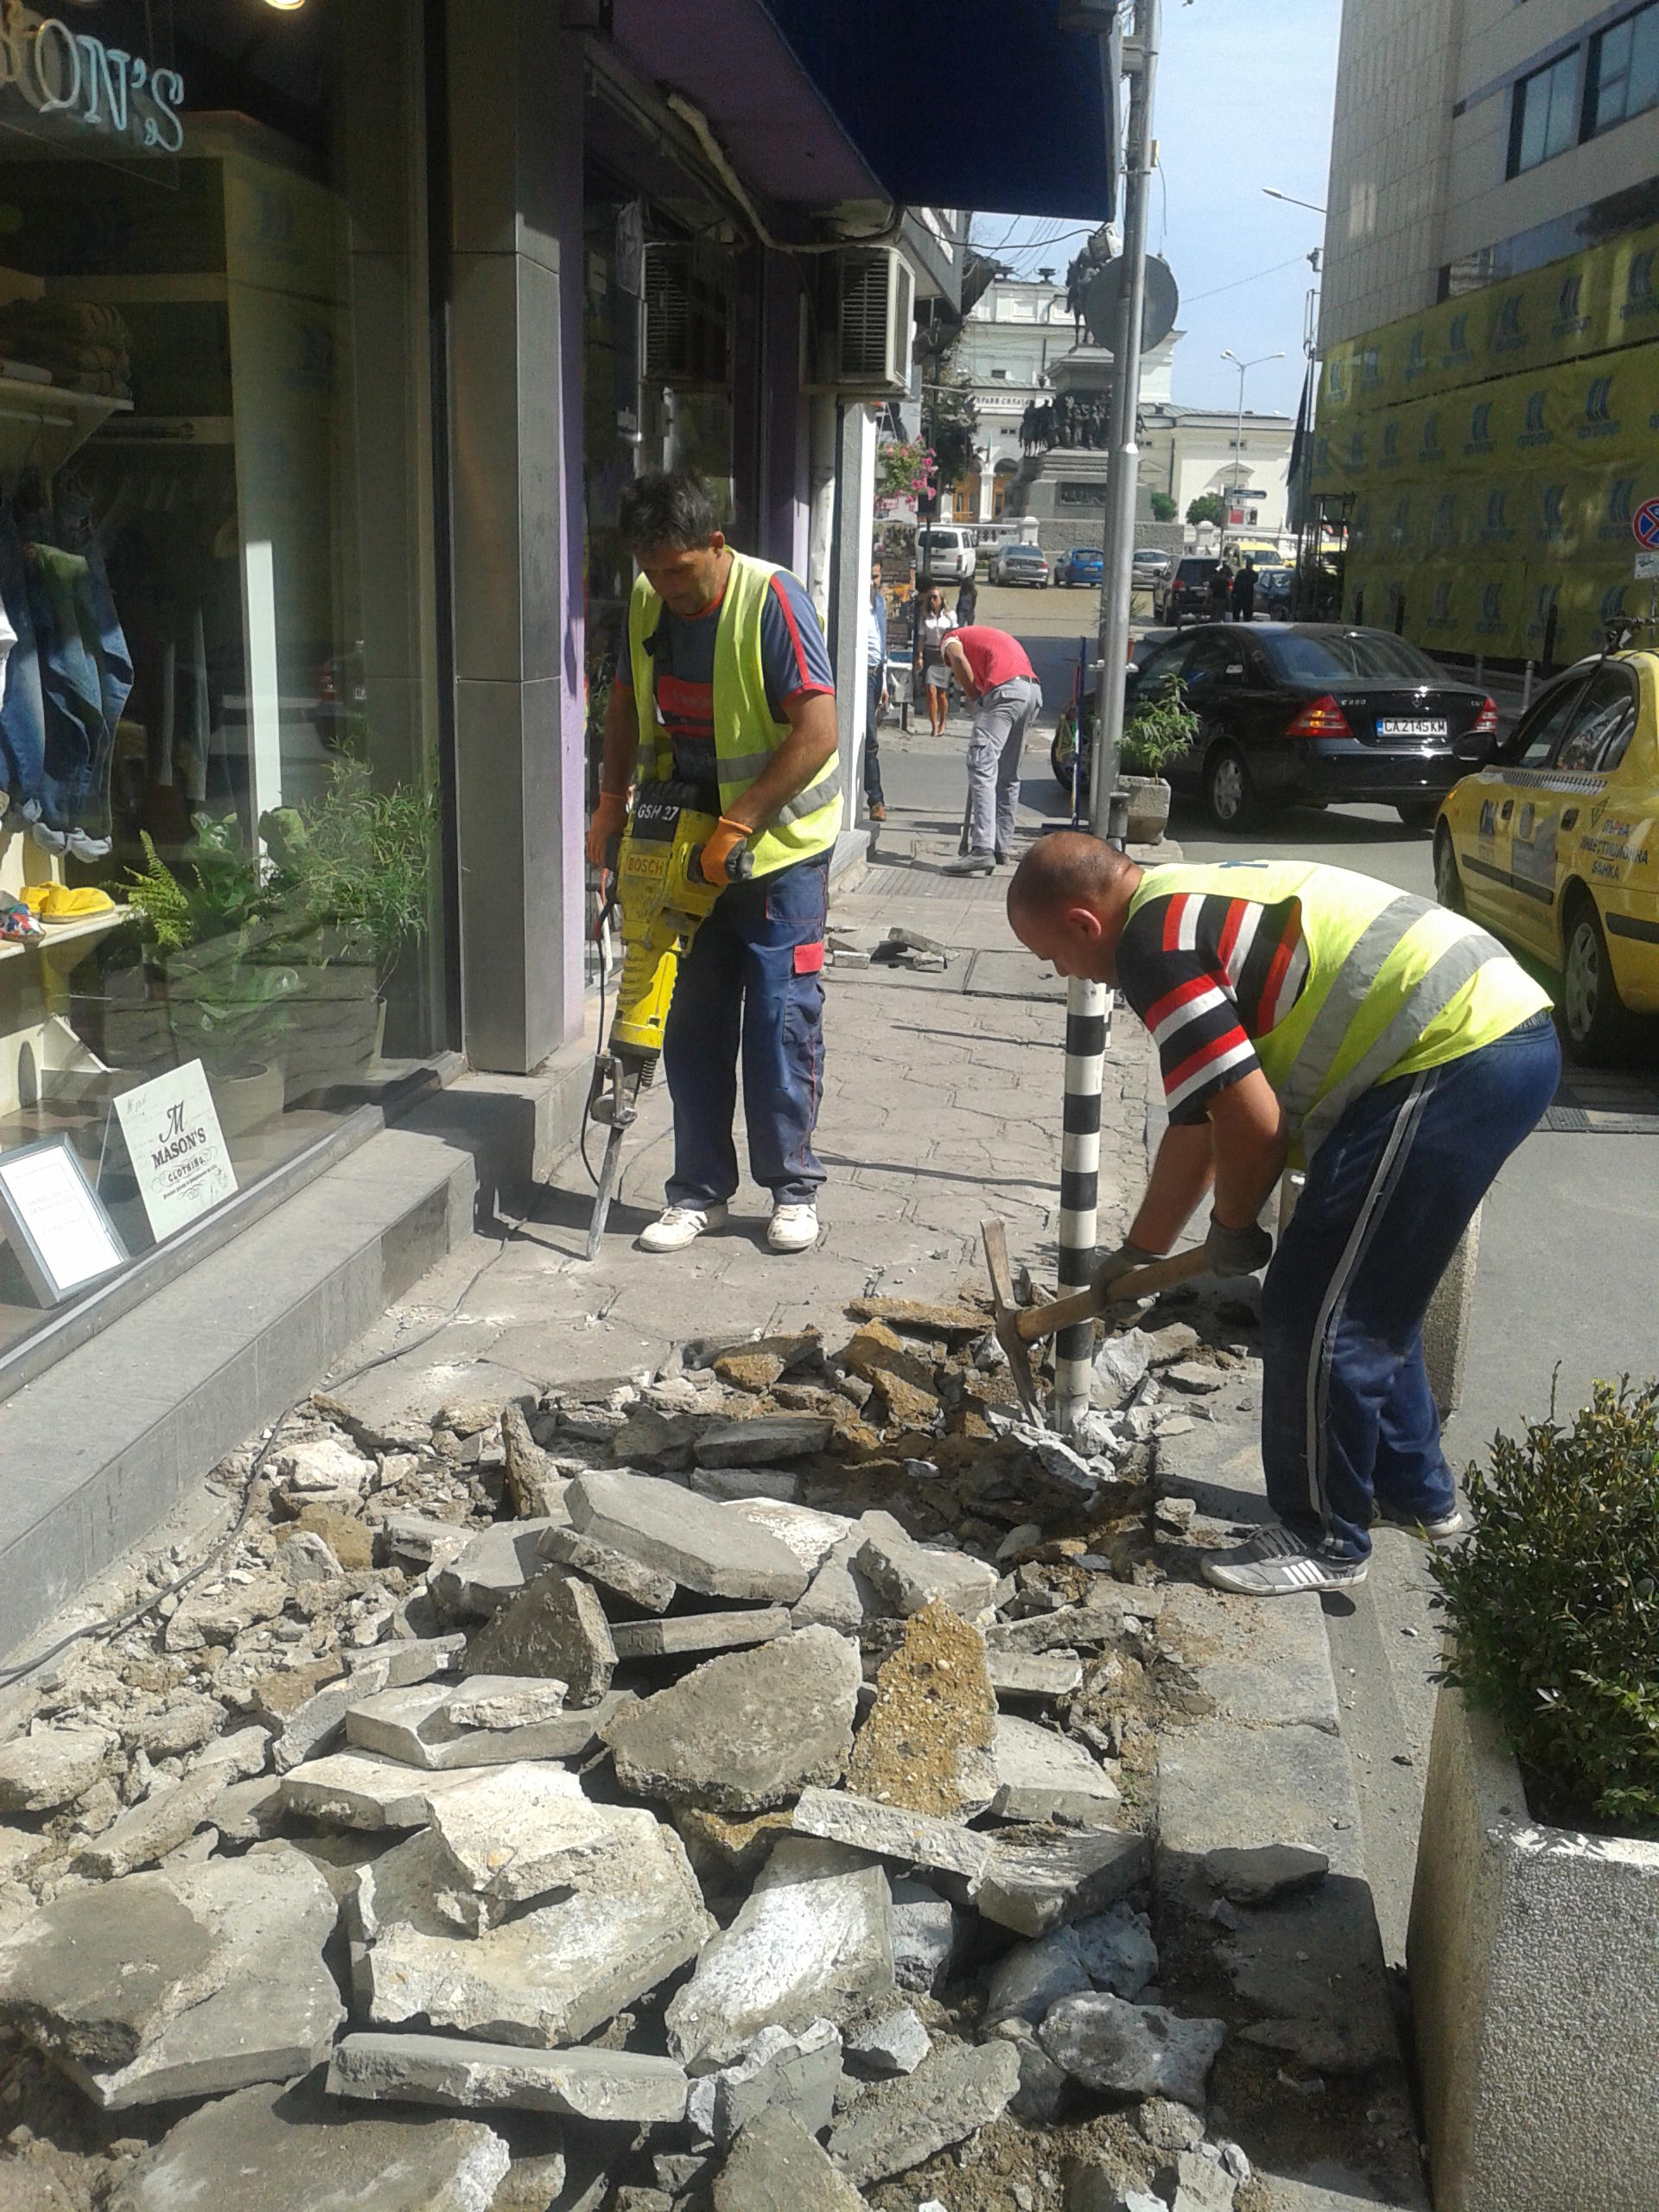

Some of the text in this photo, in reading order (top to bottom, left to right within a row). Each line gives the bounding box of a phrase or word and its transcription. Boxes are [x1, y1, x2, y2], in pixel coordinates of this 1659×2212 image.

[638, 804, 662, 819] GSH
[627, 856, 664, 875] BOSCH
[150, 1127, 207, 1169] MASON'S
